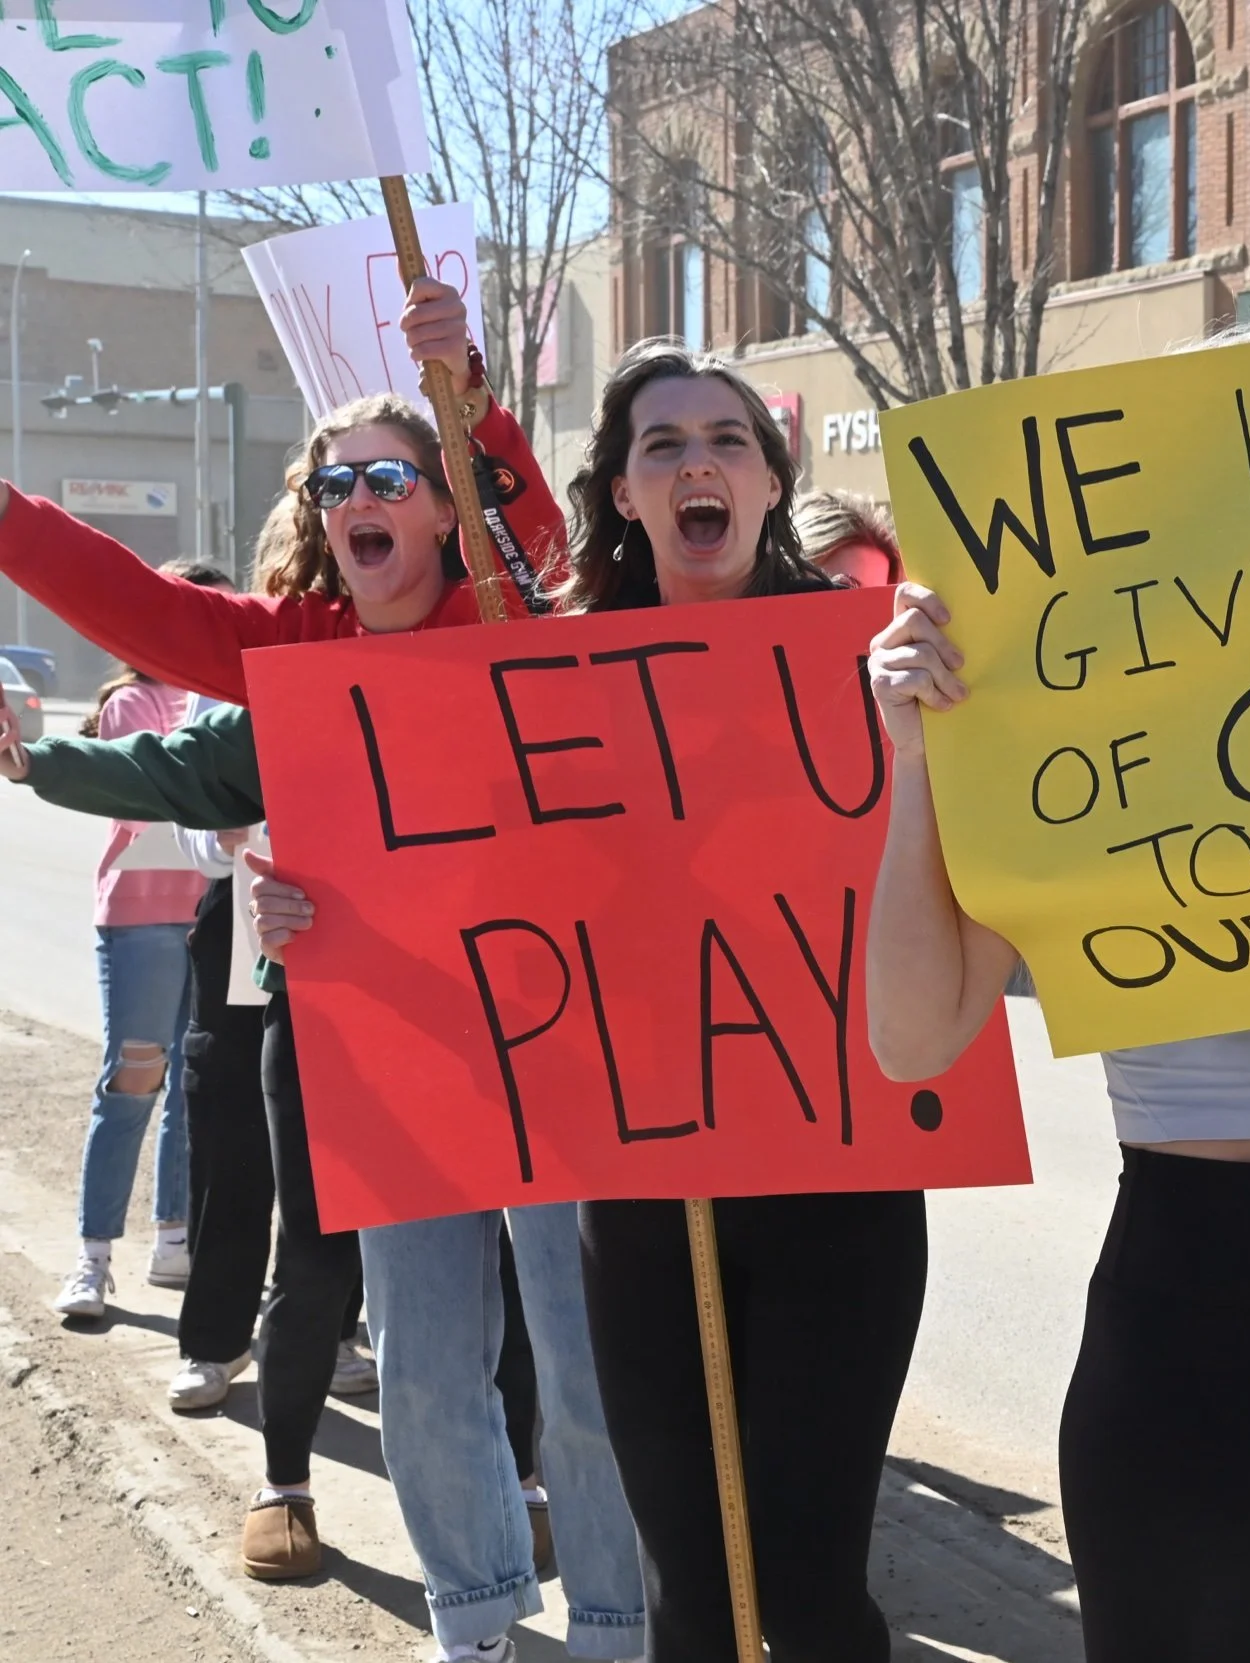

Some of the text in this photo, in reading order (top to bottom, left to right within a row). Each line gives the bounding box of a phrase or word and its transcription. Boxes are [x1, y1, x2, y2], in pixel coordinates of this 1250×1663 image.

[484, 508, 533, 586] DARKSIDE GYM
[908, 409, 1150, 594] WE
[350, 641, 886, 851] LET U
[1032, 731, 1151, 824] OF
[459, 887, 943, 1184] PLAY
